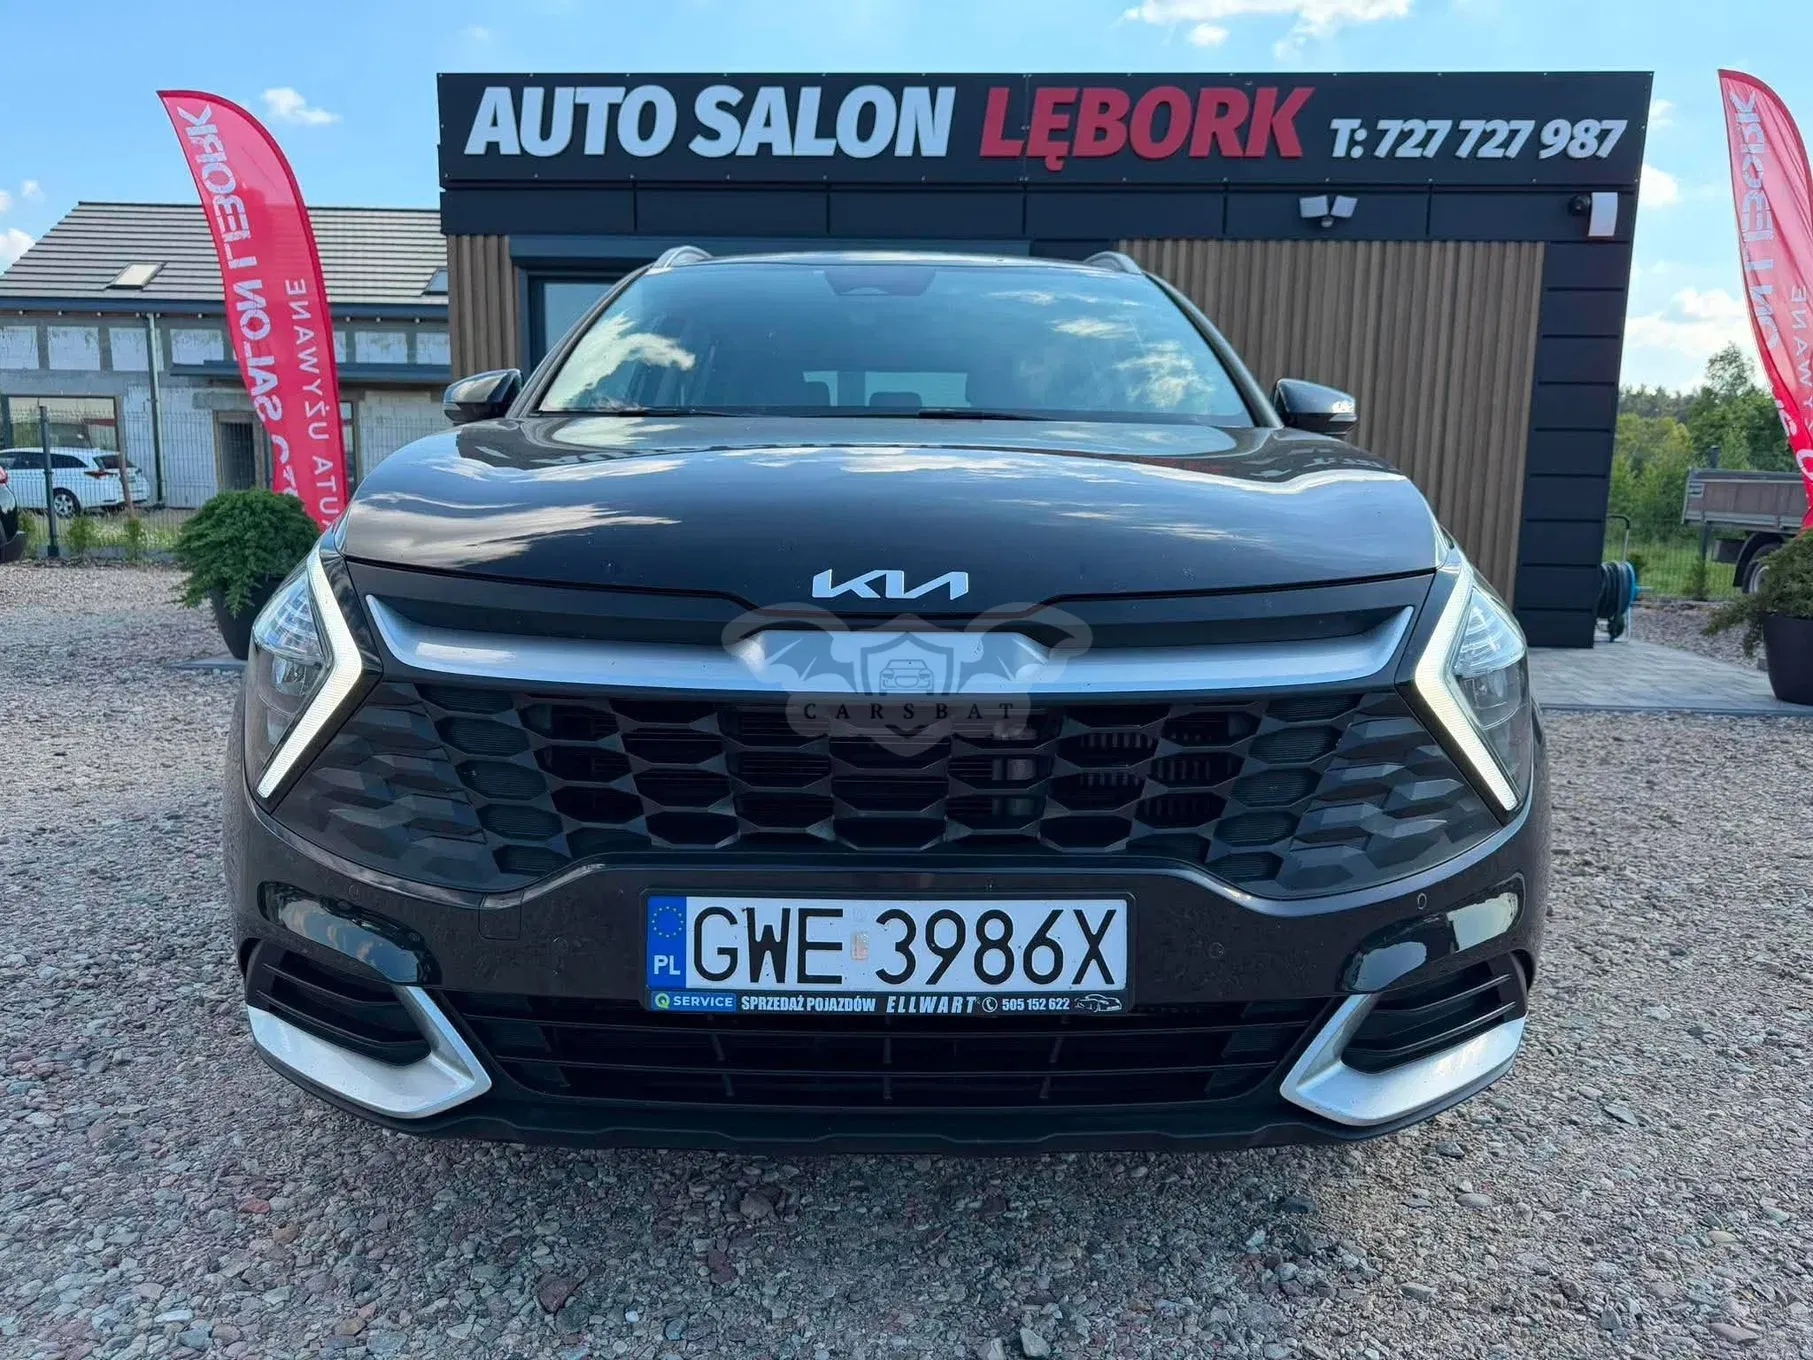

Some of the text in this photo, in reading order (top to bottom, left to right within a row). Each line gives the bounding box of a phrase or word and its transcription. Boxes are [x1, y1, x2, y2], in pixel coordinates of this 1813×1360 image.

[463, 84, 1316, 172] AUTO SALON LĘBORK
[1329, 118, 1629, 160] T: 727 727 987
[811, 568, 969, 600] KIA
[693, 906, 1117, 985] GWE 3986X
[653, 954, 681, 976] PL
[673, 996, 733, 1007] SERVICE
[741, 995, 1070, 1013] SPRZEDAŻ POJAZDÓW ELLWART 505 152 622
